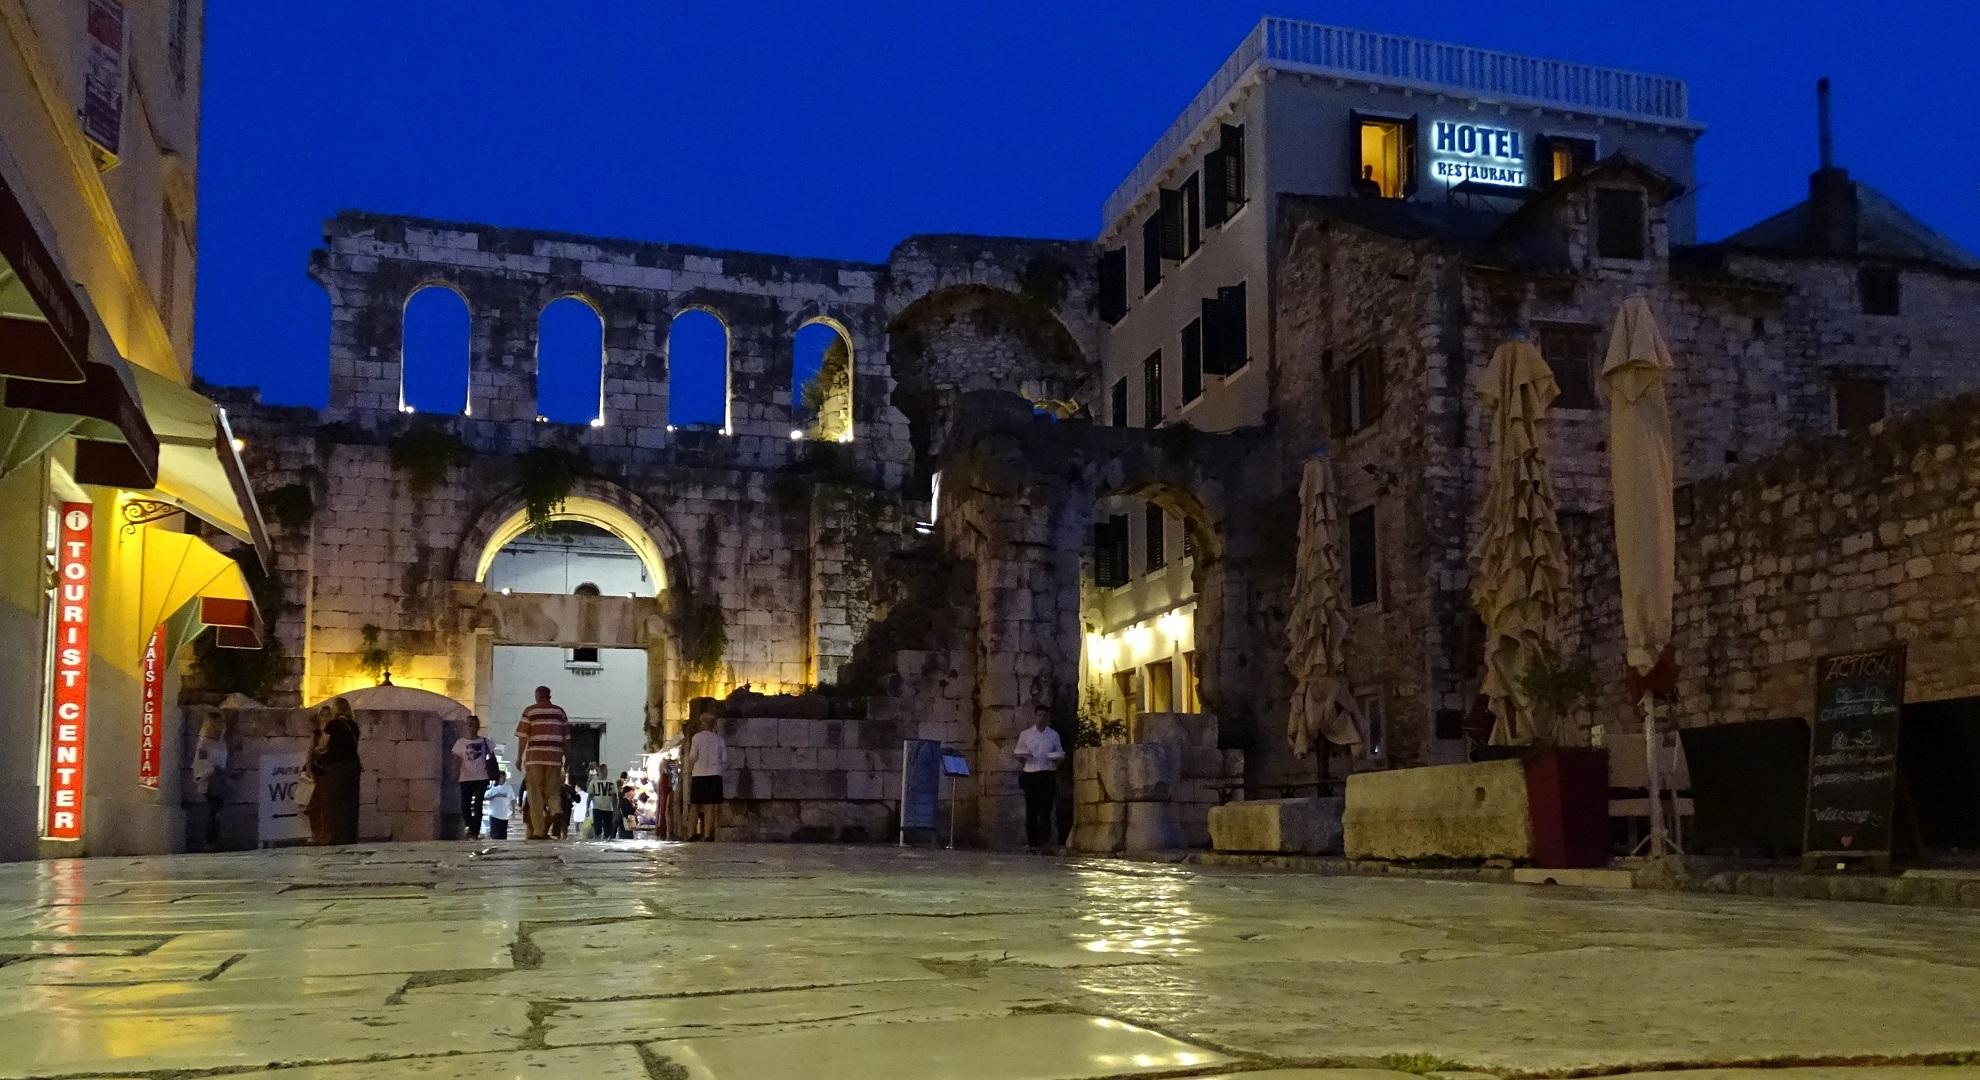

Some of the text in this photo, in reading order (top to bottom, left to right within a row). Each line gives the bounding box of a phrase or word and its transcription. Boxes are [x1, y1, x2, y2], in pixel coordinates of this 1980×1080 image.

[1436, 121, 1525, 160] HOTEL
[1437, 161, 1524, 184] RESTAURANT
[54, 541, 87, 829] TOURIST CENTER
[142, 700, 155, 772] CROATA
[592, 781, 614, 797] LIVE
